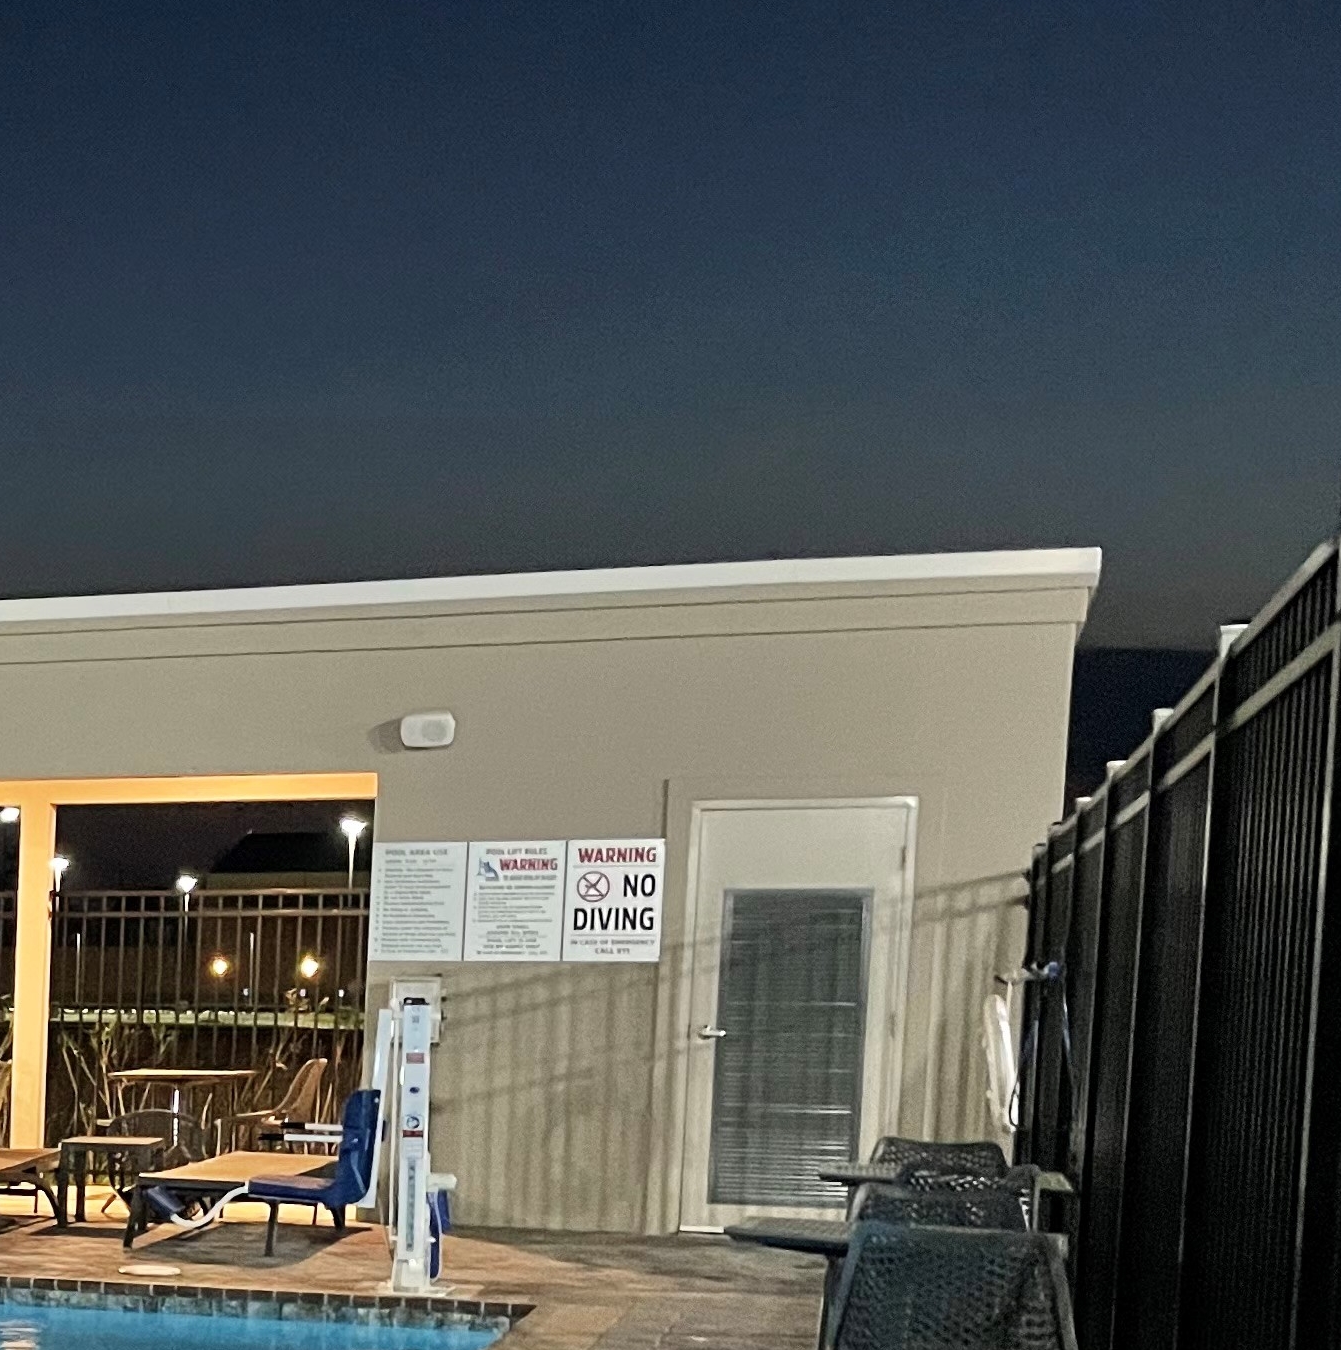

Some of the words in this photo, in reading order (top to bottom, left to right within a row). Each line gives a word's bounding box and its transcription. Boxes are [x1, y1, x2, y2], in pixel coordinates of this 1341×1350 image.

[499, 858, 558, 871] WARNING
[578, 847, 657, 863] WARNING
[623, 873, 656, 897] NO
[573, 907, 654, 931] DIVING
